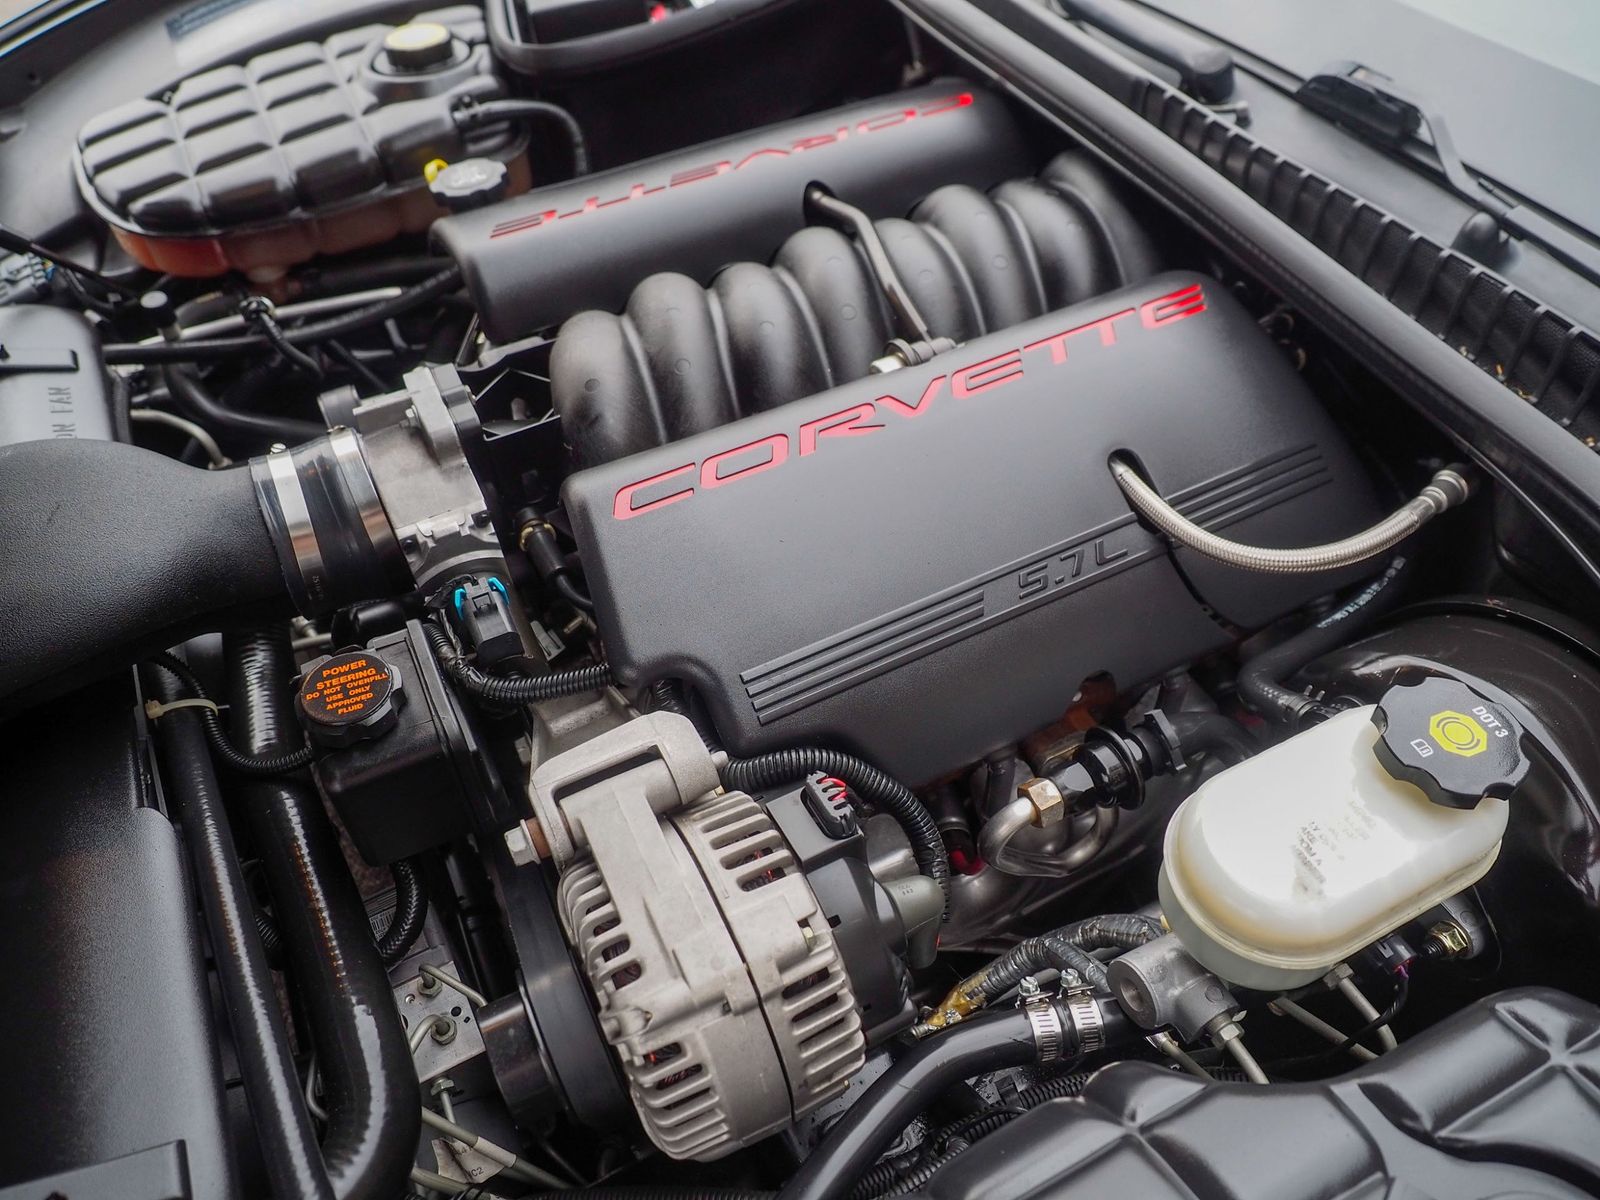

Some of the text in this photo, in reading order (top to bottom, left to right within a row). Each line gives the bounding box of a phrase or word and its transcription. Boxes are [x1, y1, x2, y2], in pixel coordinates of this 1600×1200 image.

[490, 91, 974, 239] CORVETTE
[612, 283, 1208, 521] CORVETTE
[1018, 539, 1129, 600] 5.7L
[316, 668, 376, 689] STEERING
[322, 660, 366, 678] POWER
[306, 673, 388, 701] DO NOT OVERFILL
[326, 684, 371, 702] USE ONLY
[326, 692, 374, 710] APPROVED
[338, 703, 364, 715] FLUID
[1472, 706, 1509, 738] DOT 3
